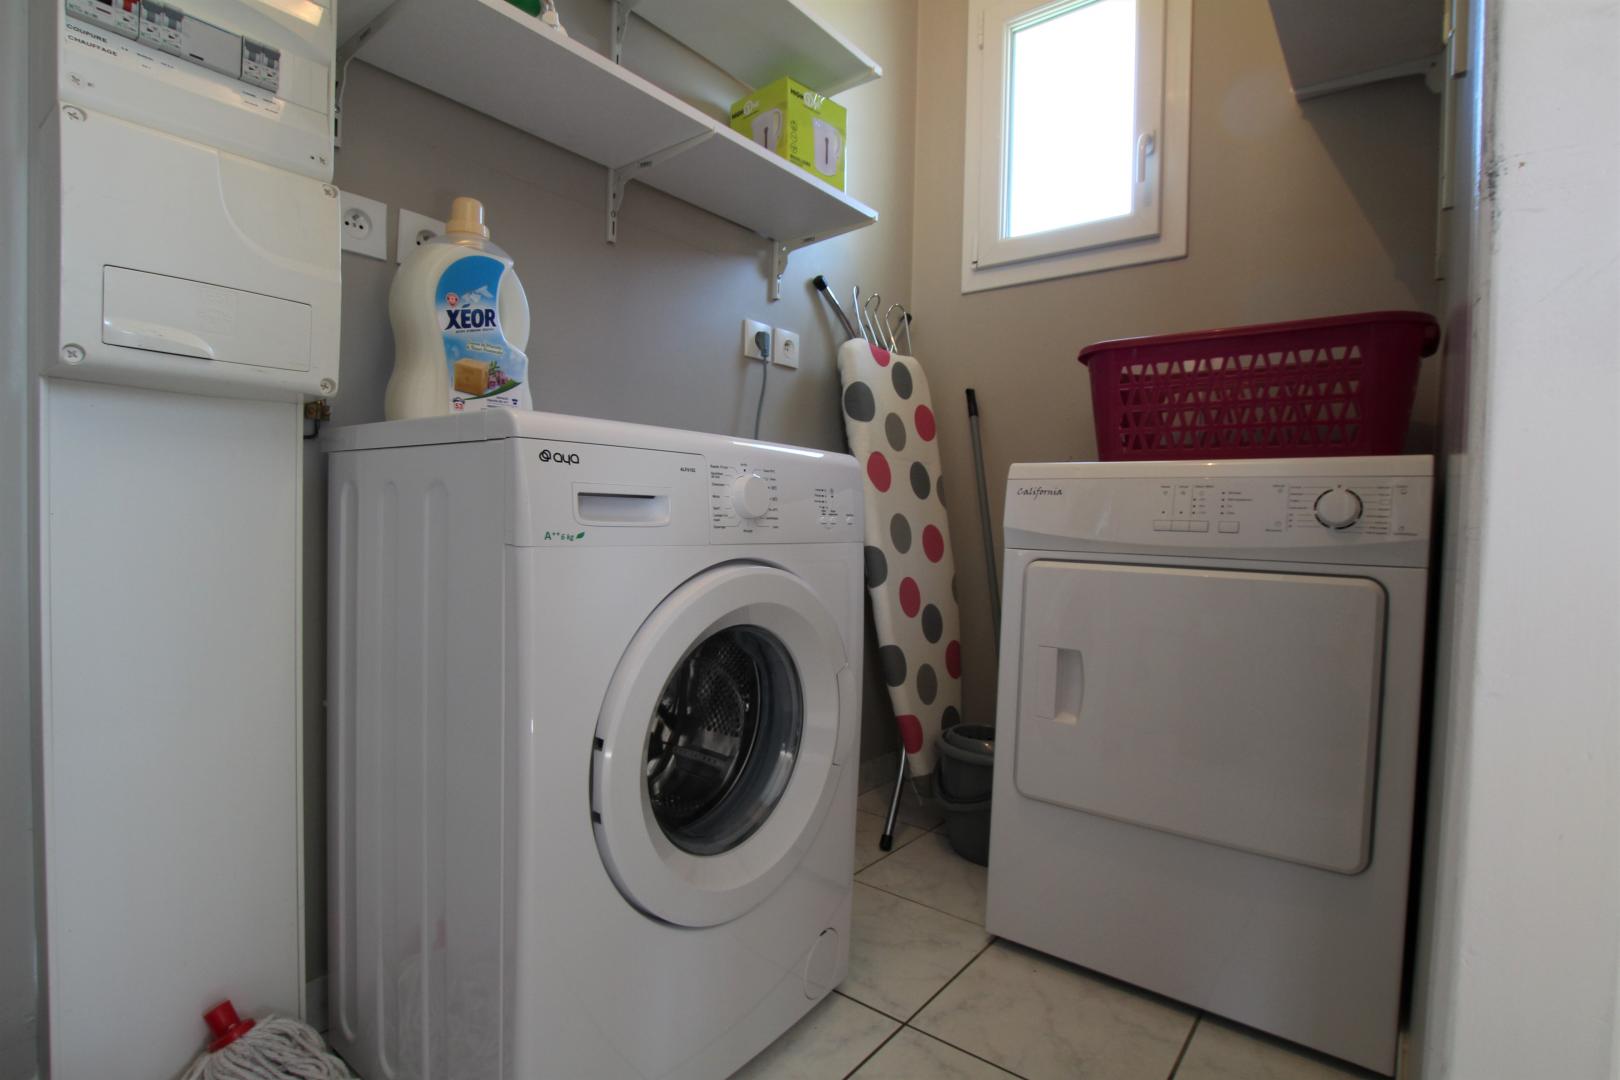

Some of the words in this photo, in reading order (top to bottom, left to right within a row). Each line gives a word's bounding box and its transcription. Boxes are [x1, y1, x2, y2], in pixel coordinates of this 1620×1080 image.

[66, 23, 107, 43] COUPURE
[67, 35, 117, 56] CHAUFFAGE
[444, 304, 496, 331] XÉOR
[553, 452, 580, 465] aya
[1017, 487, 1063, 500] California
